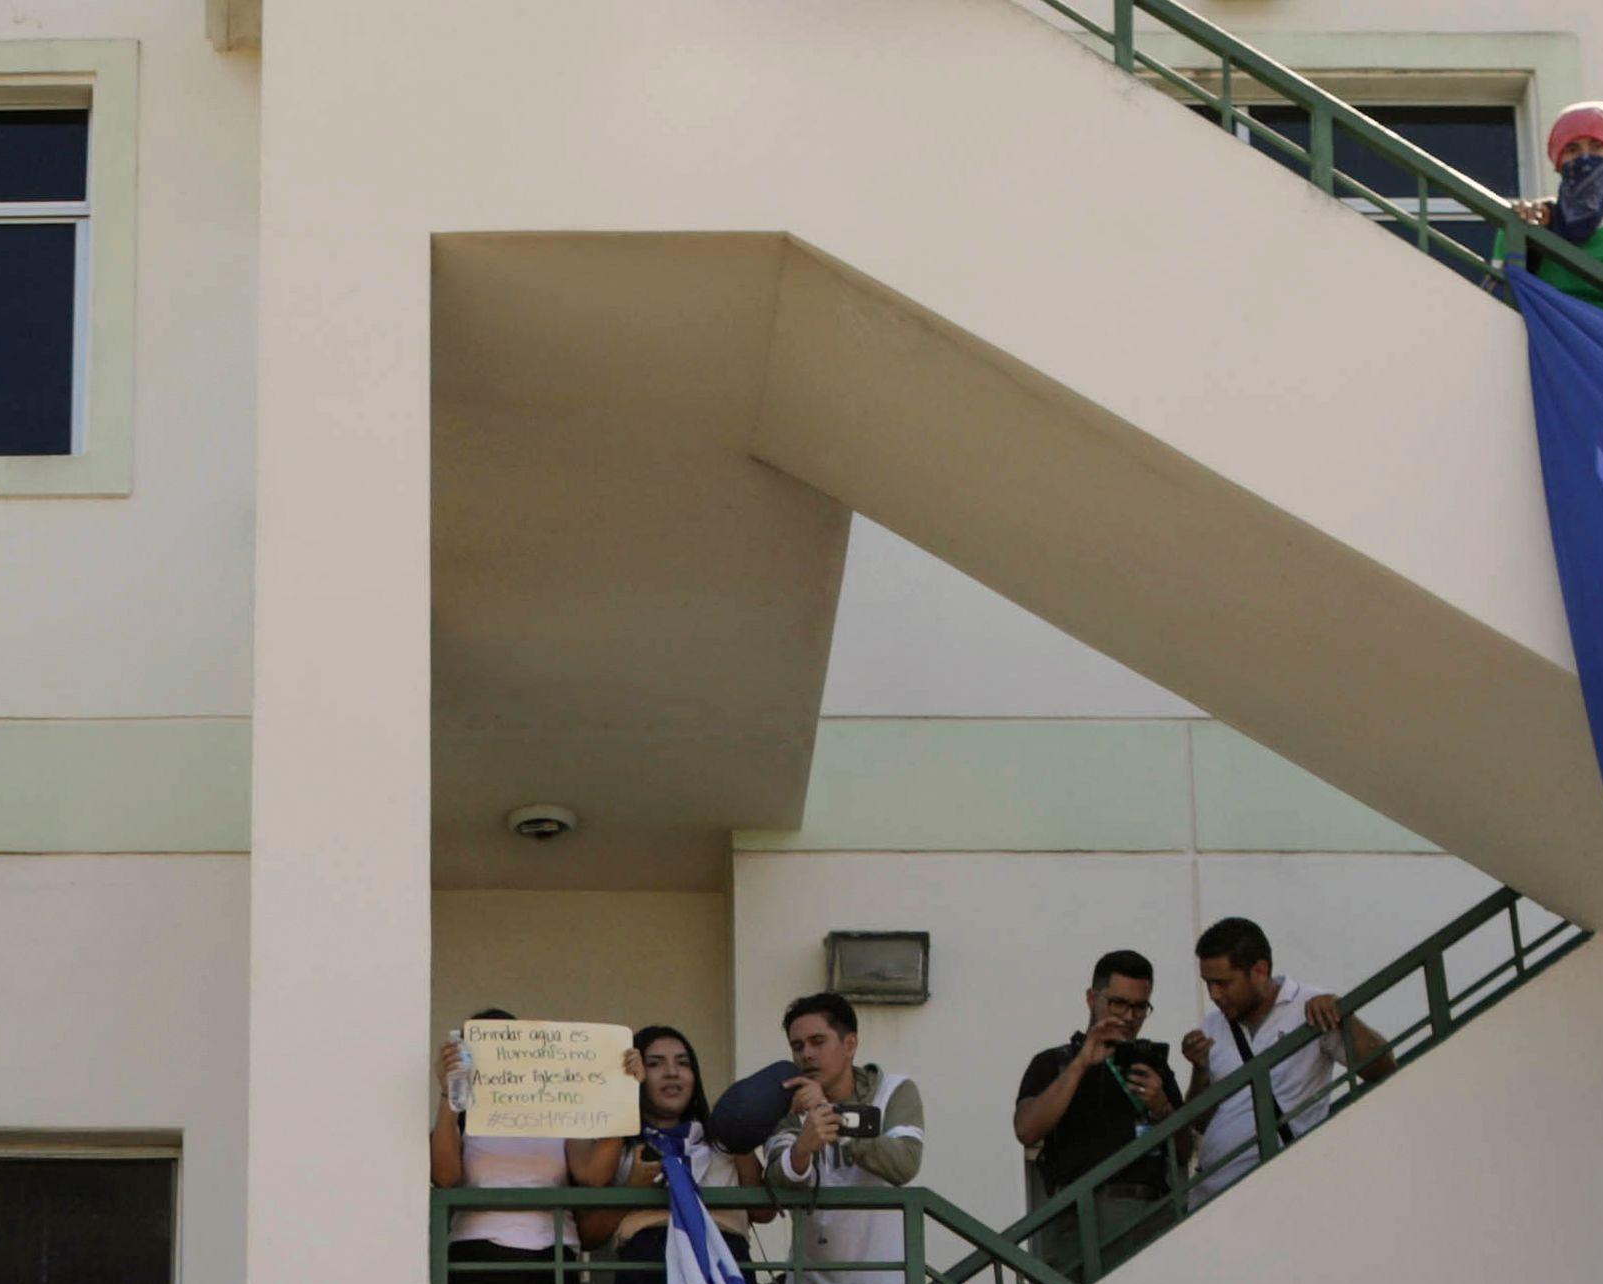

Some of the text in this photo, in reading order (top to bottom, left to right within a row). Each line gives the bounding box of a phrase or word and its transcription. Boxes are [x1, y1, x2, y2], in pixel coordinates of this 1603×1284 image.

[529, 1030, 561, 1047] agua
[570, 1030, 589, 1042] es
[497, 1044, 598, 1061] Humanismo
[588, 1072, 607, 1085] es
